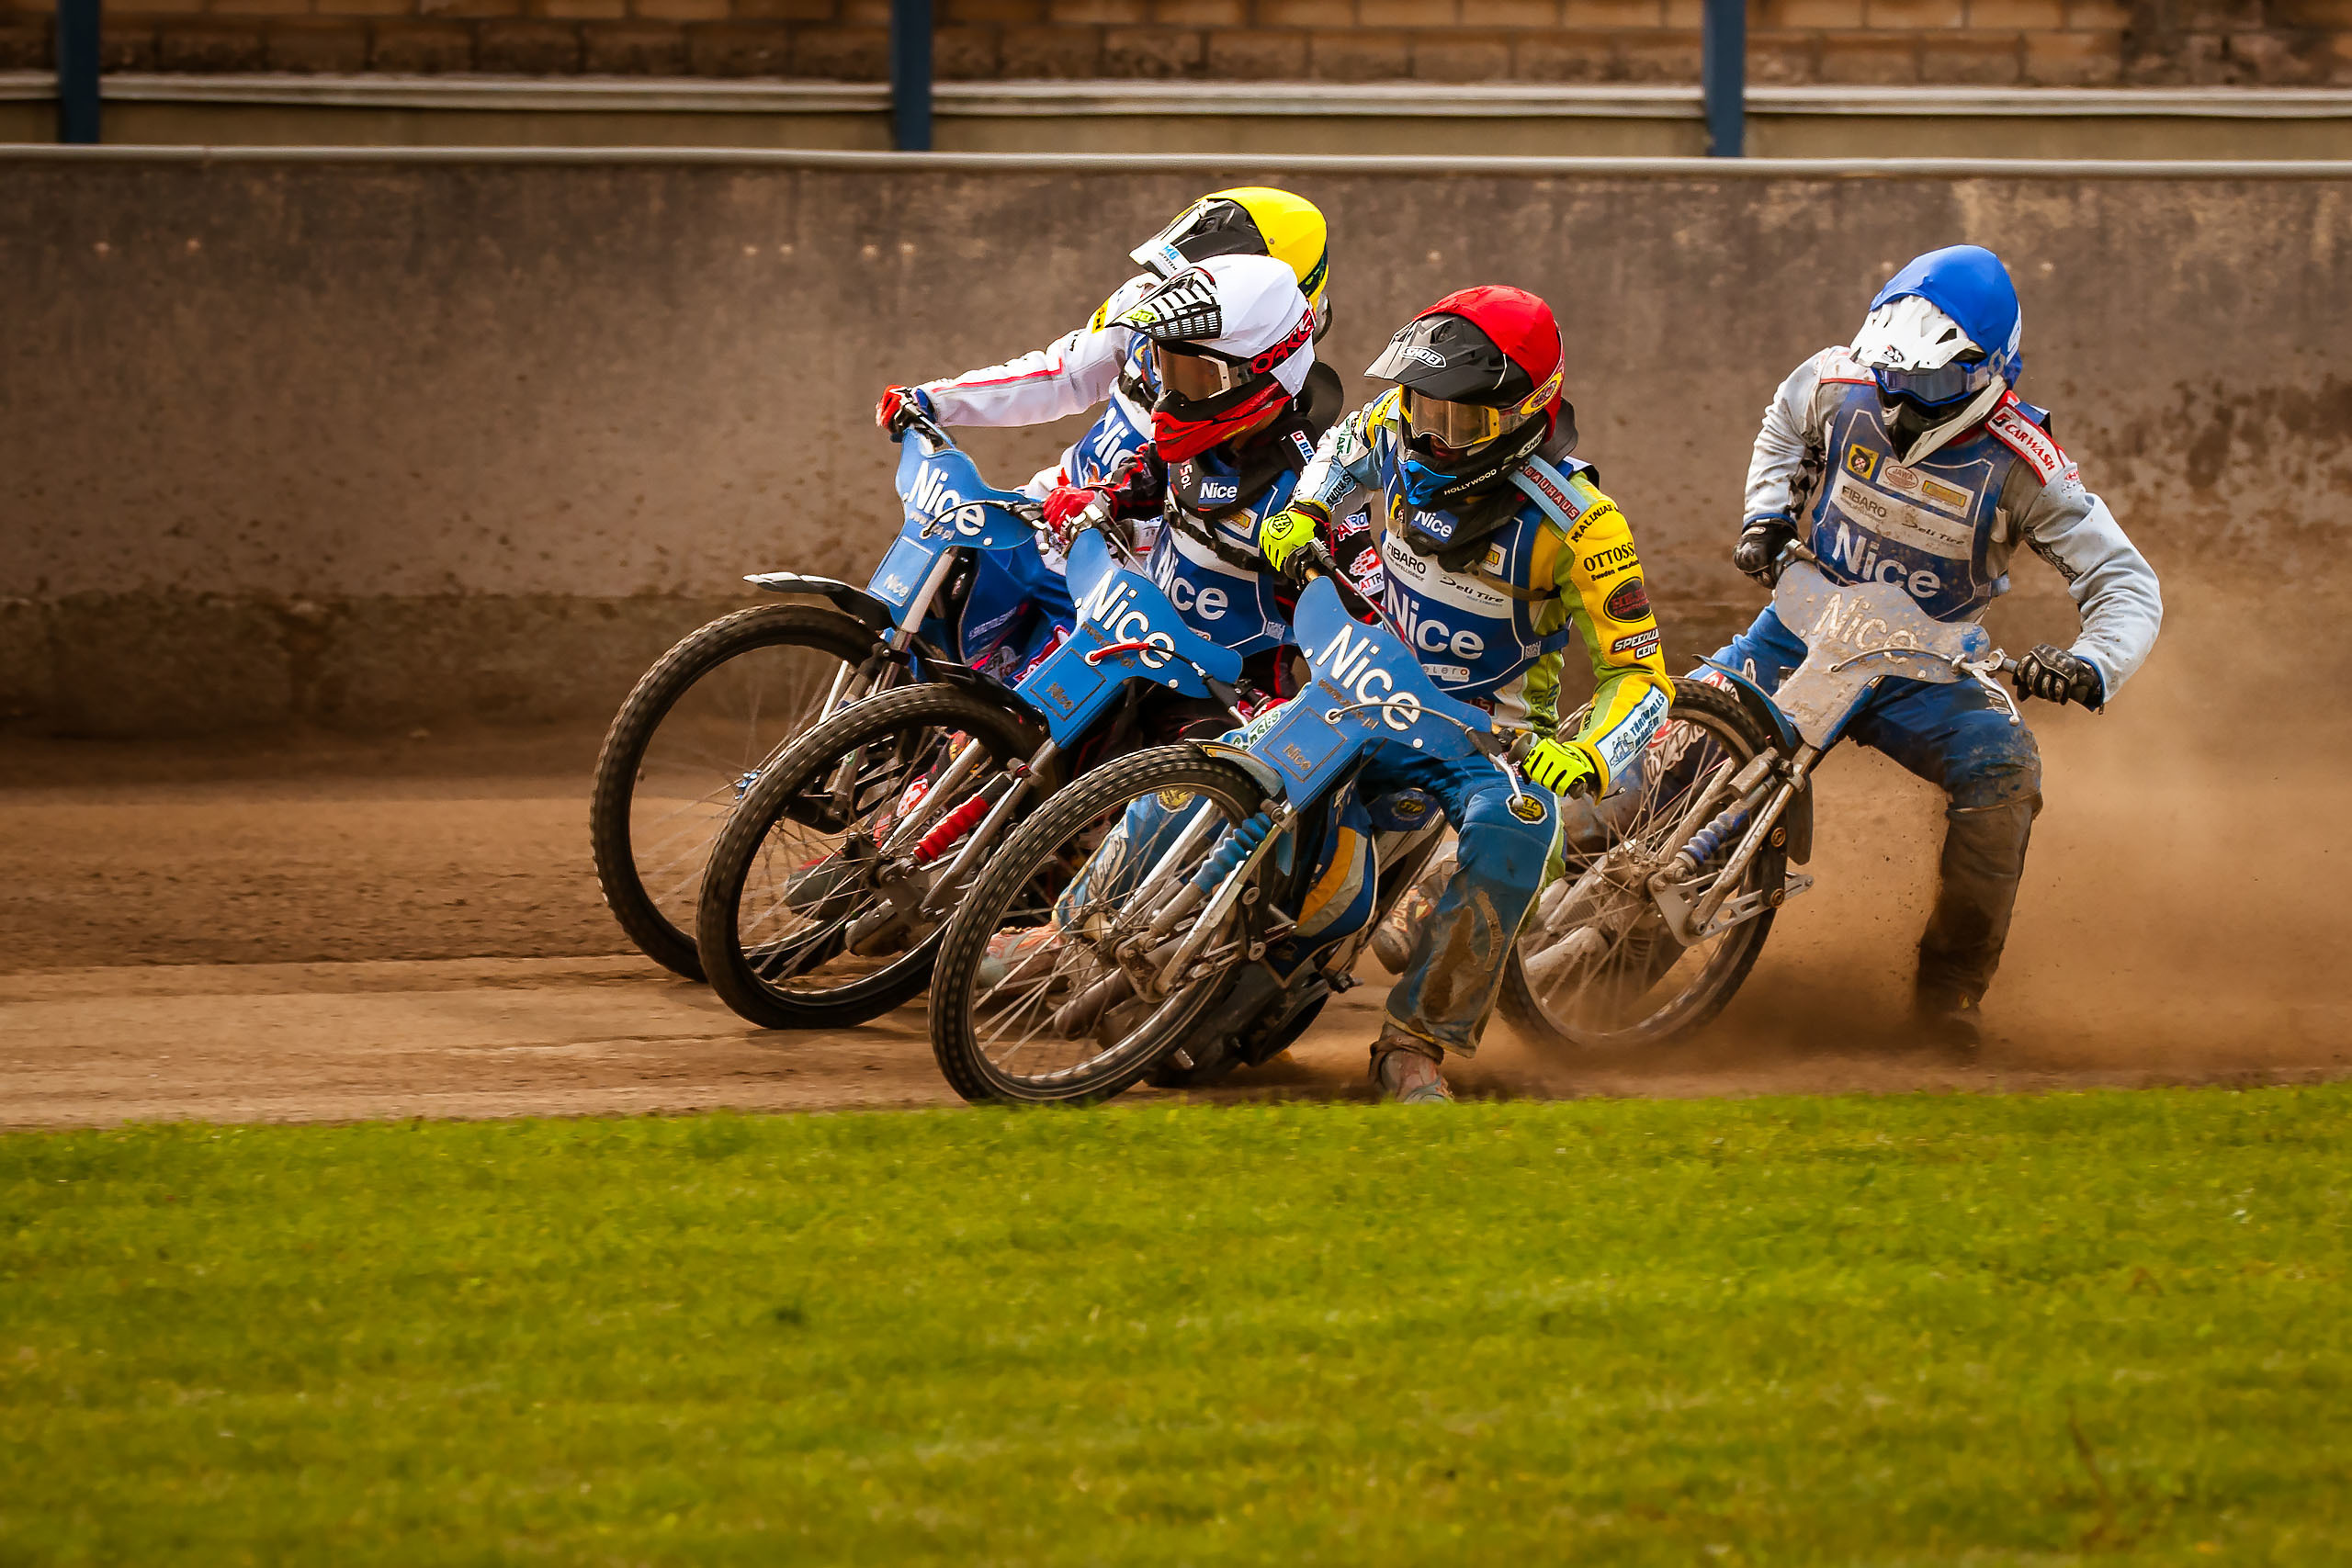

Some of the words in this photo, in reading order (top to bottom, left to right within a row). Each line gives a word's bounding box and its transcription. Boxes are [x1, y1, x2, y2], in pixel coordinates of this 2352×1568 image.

[1403, 347, 1442, 367] SHOEI
[2004, 423, 2029, 443] CAR
[2026, 436, 2056, 471] WASH
[1443, 468, 1498, 496] HOLLYWOOD
[1892, 467, 1914, 482] JAWA
[905, 459, 986, 536] Nice
[1199, 482, 1238, 501] Nice
[1525, 467, 1579, 520] BAUHAUS
[1841, 485, 1887, 518] FIBARO
[1414, 510, 1453, 537] Nice
[1386, 542, 1427, 575] FIBARO
[1831, 520, 1940, 598] Nice
[1590, 570, 1616, 582] Sweden
[1476, 591, 1505, 604] Tire
[1082, 569, 1175, 669] Nice
[1387, 578, 1485, 660] Nice
[1813, 592, 1919, 665] Nice
[1316, 623, 1421, 732] Nice
[1283, 742, 1313, 772] Nice
